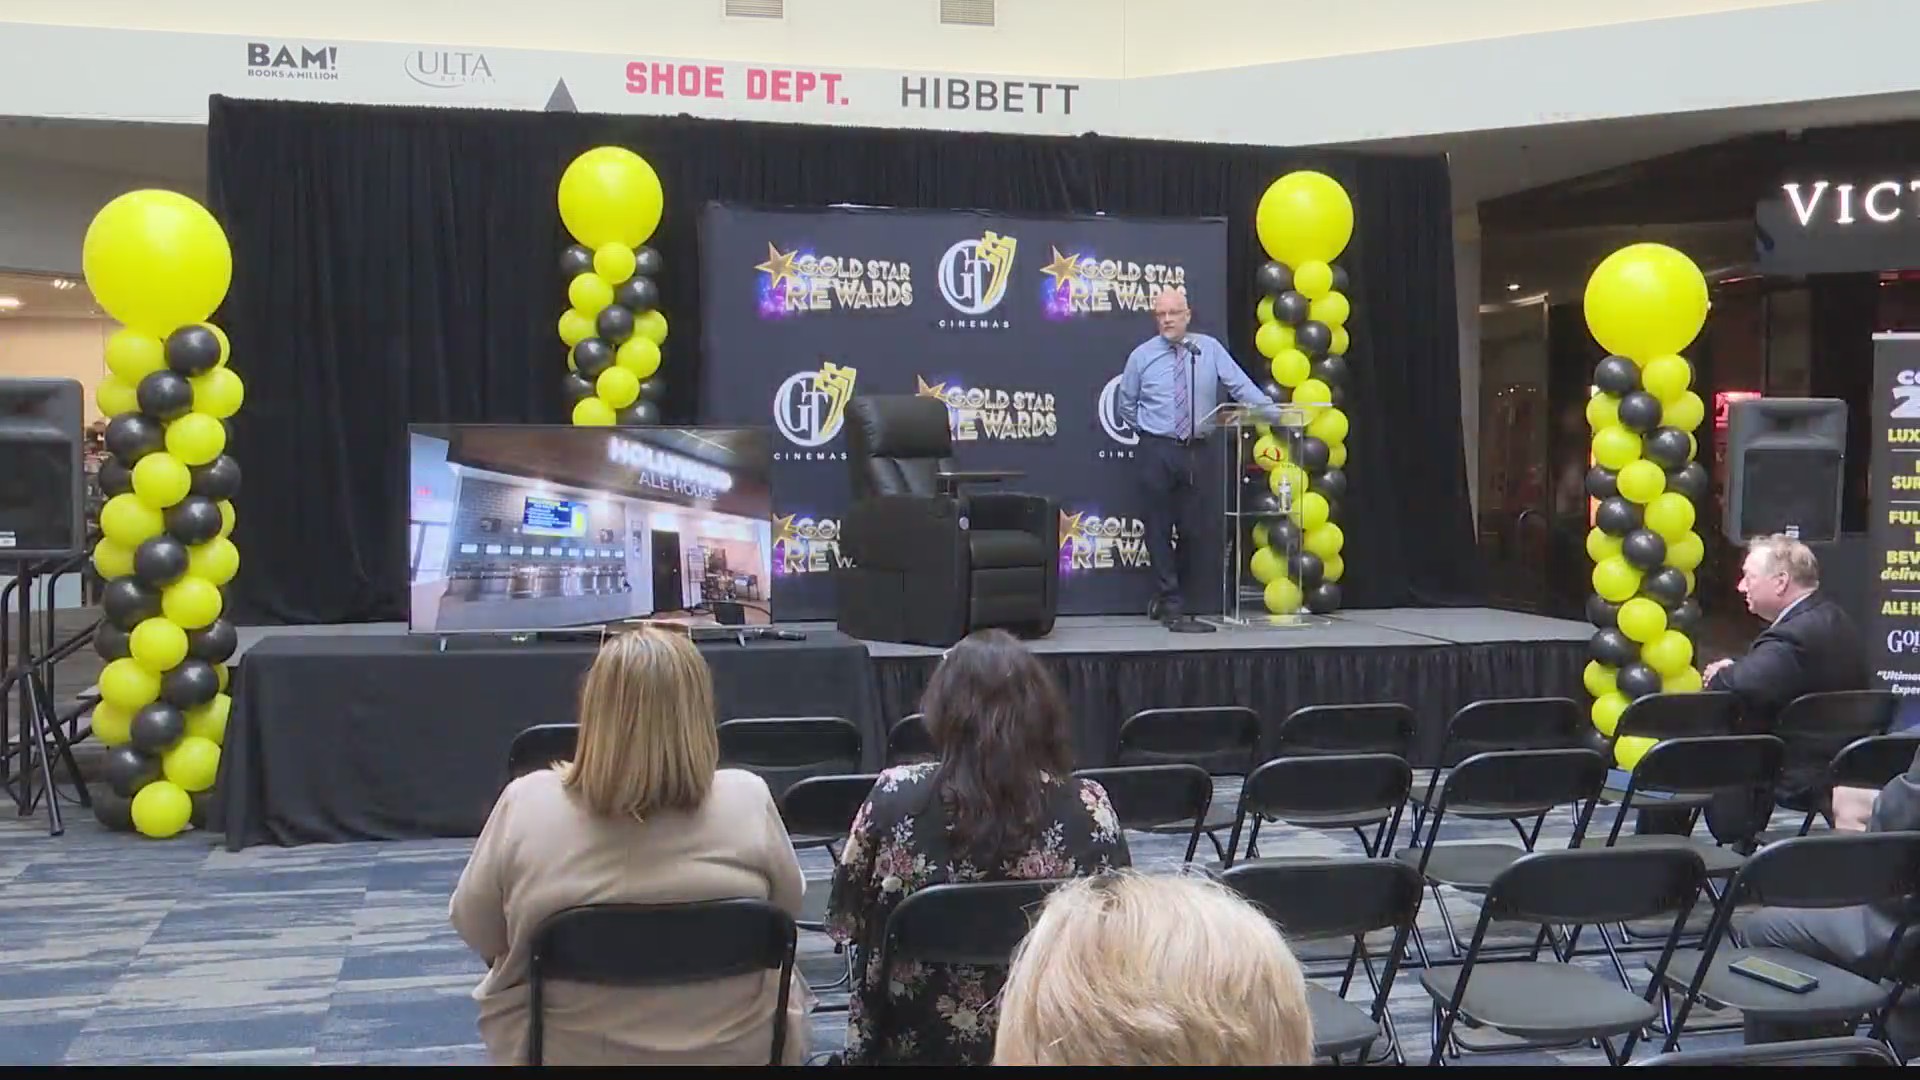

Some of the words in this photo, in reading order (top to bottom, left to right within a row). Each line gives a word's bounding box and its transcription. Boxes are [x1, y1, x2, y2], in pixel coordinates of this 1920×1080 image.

[248, 43, 337, 70] BAM!
[418, 51, 492, 77] ULTA
[626, 62, 724, 98] SHOE
[747, 69, 849, 105] DEPT.
[902, 76, 1079, 115] HIBBETT
[799, 255, 864, 278] GOLD
[867, 260, 911, 281] STAR
[1080, 258, 1141, 281] GOLD
[1144, 264, 1185, 284] STAR
[785, 276, 913, 311] REWARDS
[939, 320, 1010, 328] CINEMAS
[947, 386, 1010, 409] GOLD
[1013, 391, 1055, 412] STAR
[773, 452, 848, 460] CINEMAS
[1098, 450, 1134, 458] CINE
[639, 471, 669, 490] ALE
[672, 478, 718, 501] HOUSE
[1083, 515, 1145, 538] GOLD
[1071, 537, 1151, 569] REWA
[1881, 601, 1909, 615] ALE
